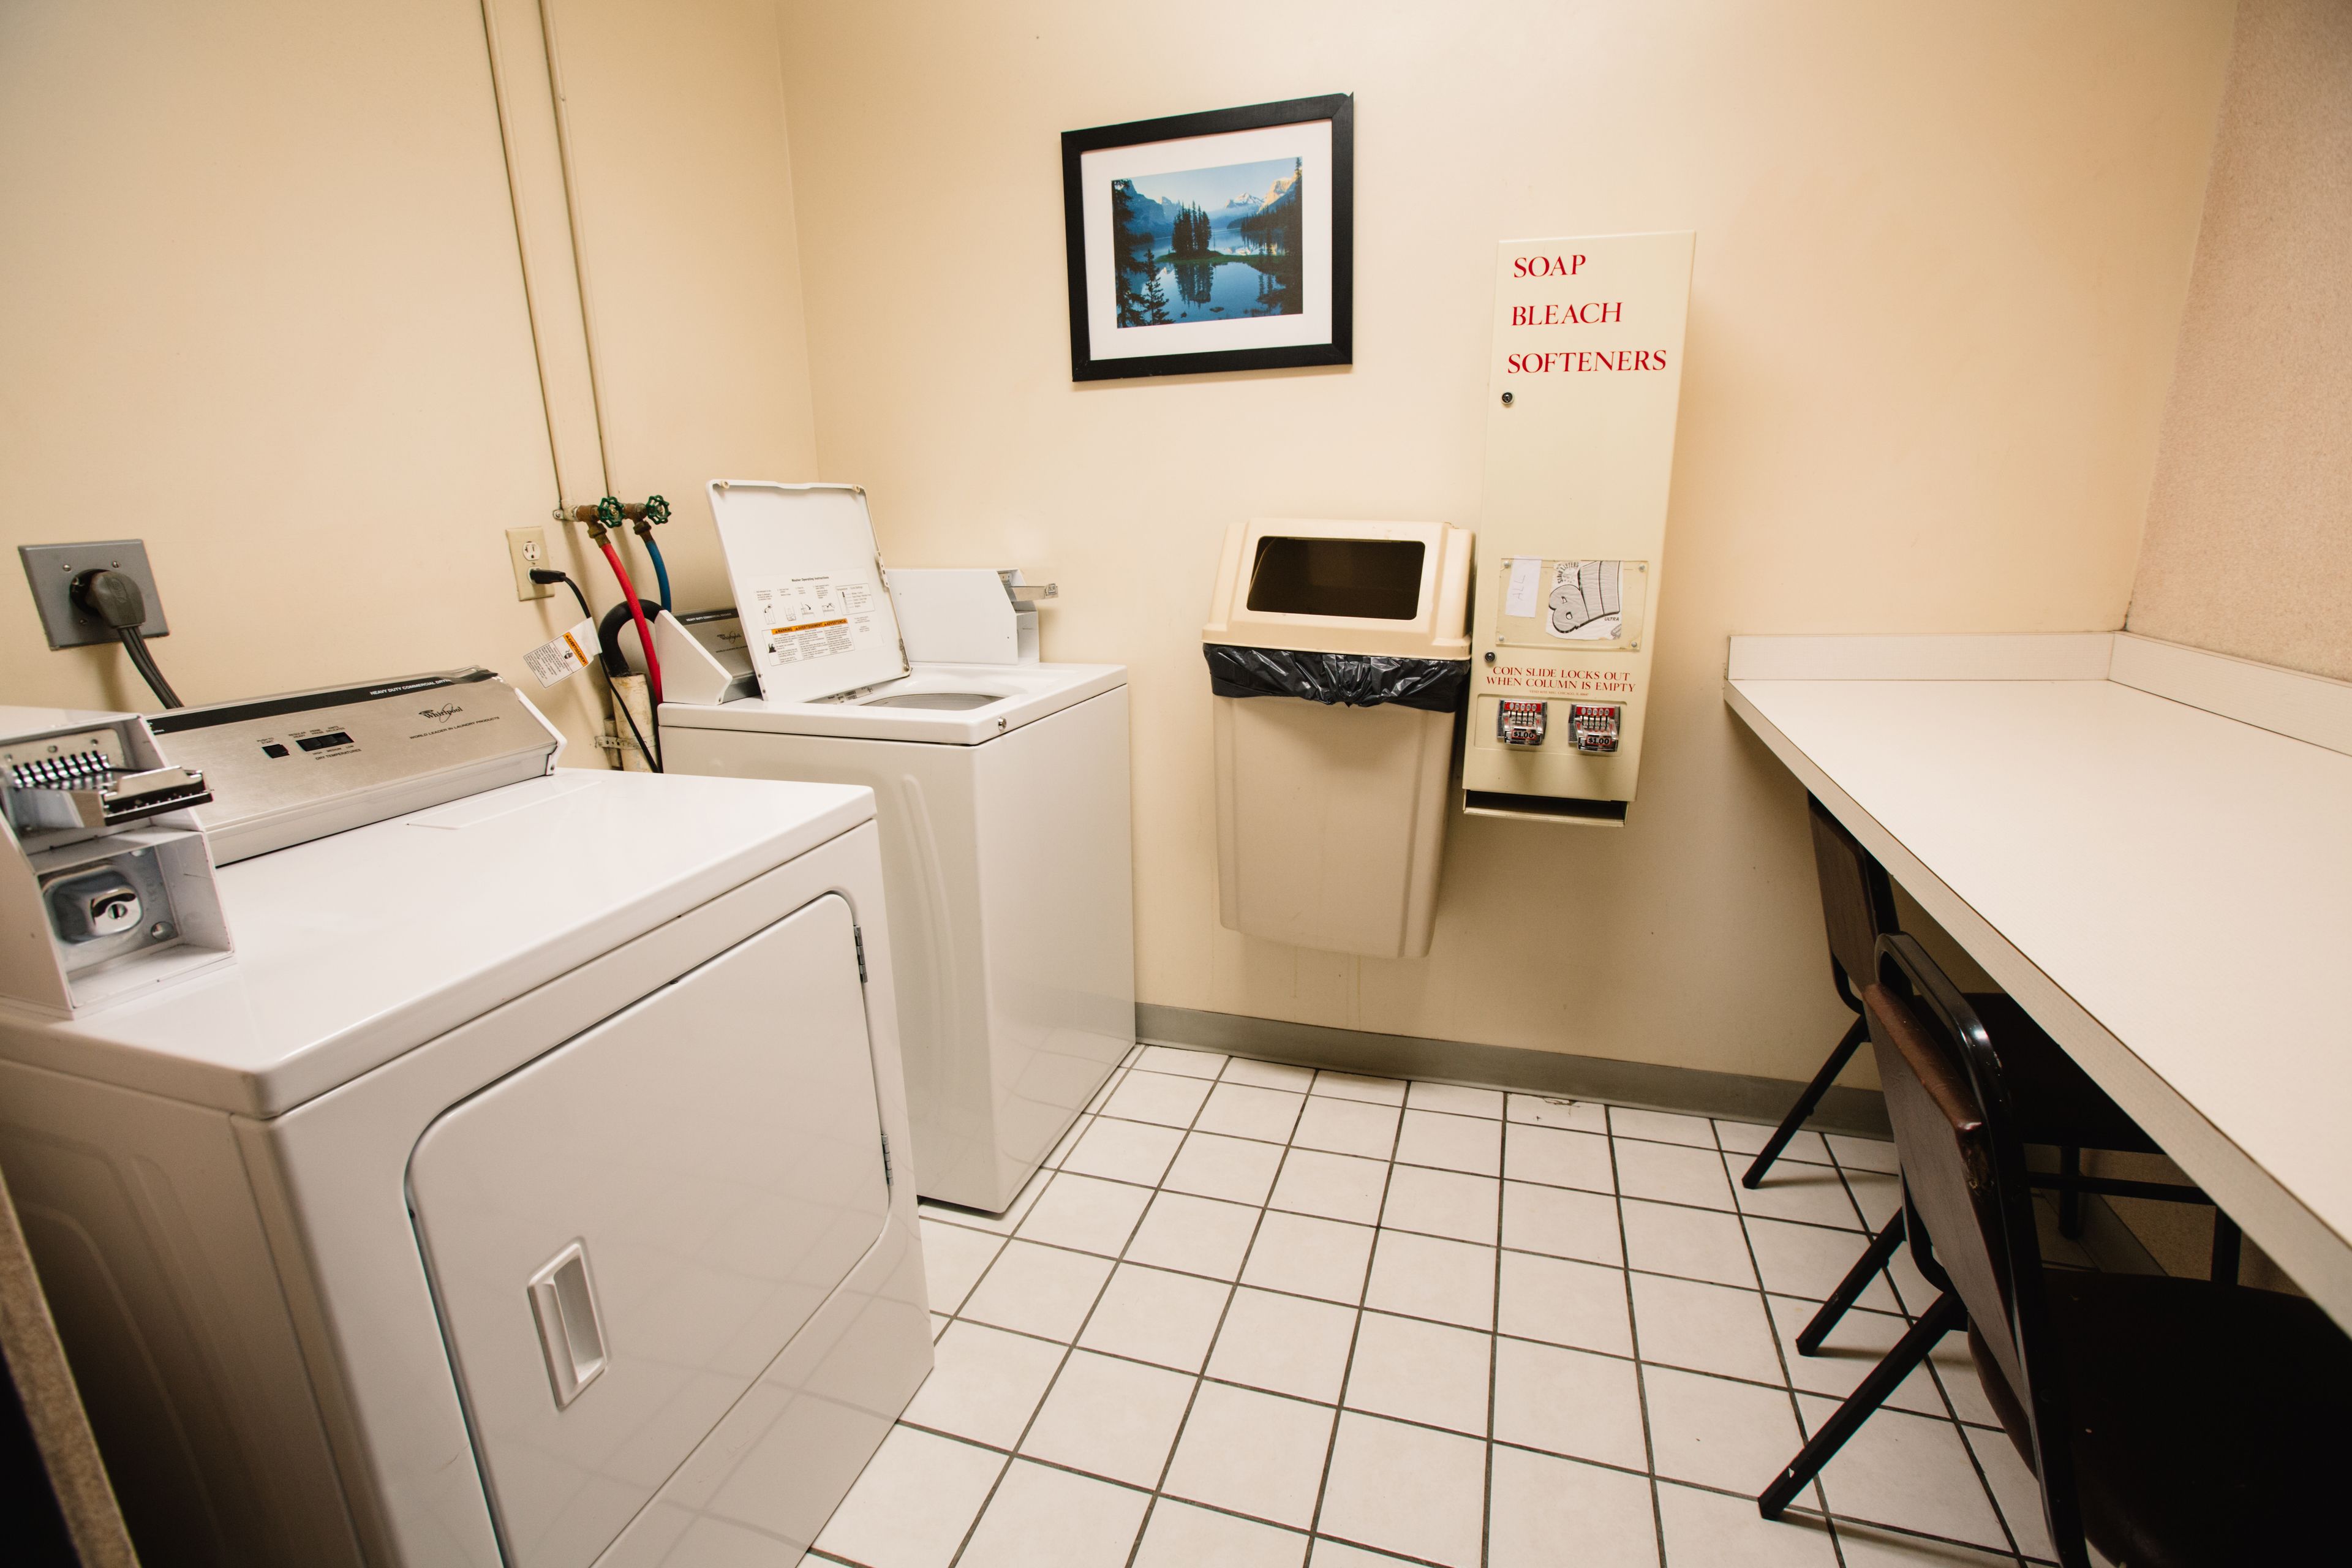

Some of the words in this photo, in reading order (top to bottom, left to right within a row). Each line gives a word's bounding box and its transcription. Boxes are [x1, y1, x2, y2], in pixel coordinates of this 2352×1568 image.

[1513, 254, 1586, 277] SOAP
[1511, 302, 1623, 326] BLEACH
[1507, 350, 1667, 374] SOFTENERS
[1512, 575, 1526, 601] ALL
[1493, 666, 1523, 676] COIN
[1526, 668, 1556, 677] SLIDE
[1561, 669, 1600, 680] LOCKS
[1604, 671, 1630, 681] OUT
[1487, 676, 1522, 686] WHEN
[1526, 678, 1577, 689] COLUMN
[1581, 681, 1591, 690] IS
[1596, 682, 1636, 692] EMPTY
[423, 706, 463, 719] Whirlpool
[327, 748, 362, 758] TEMPERATURES
